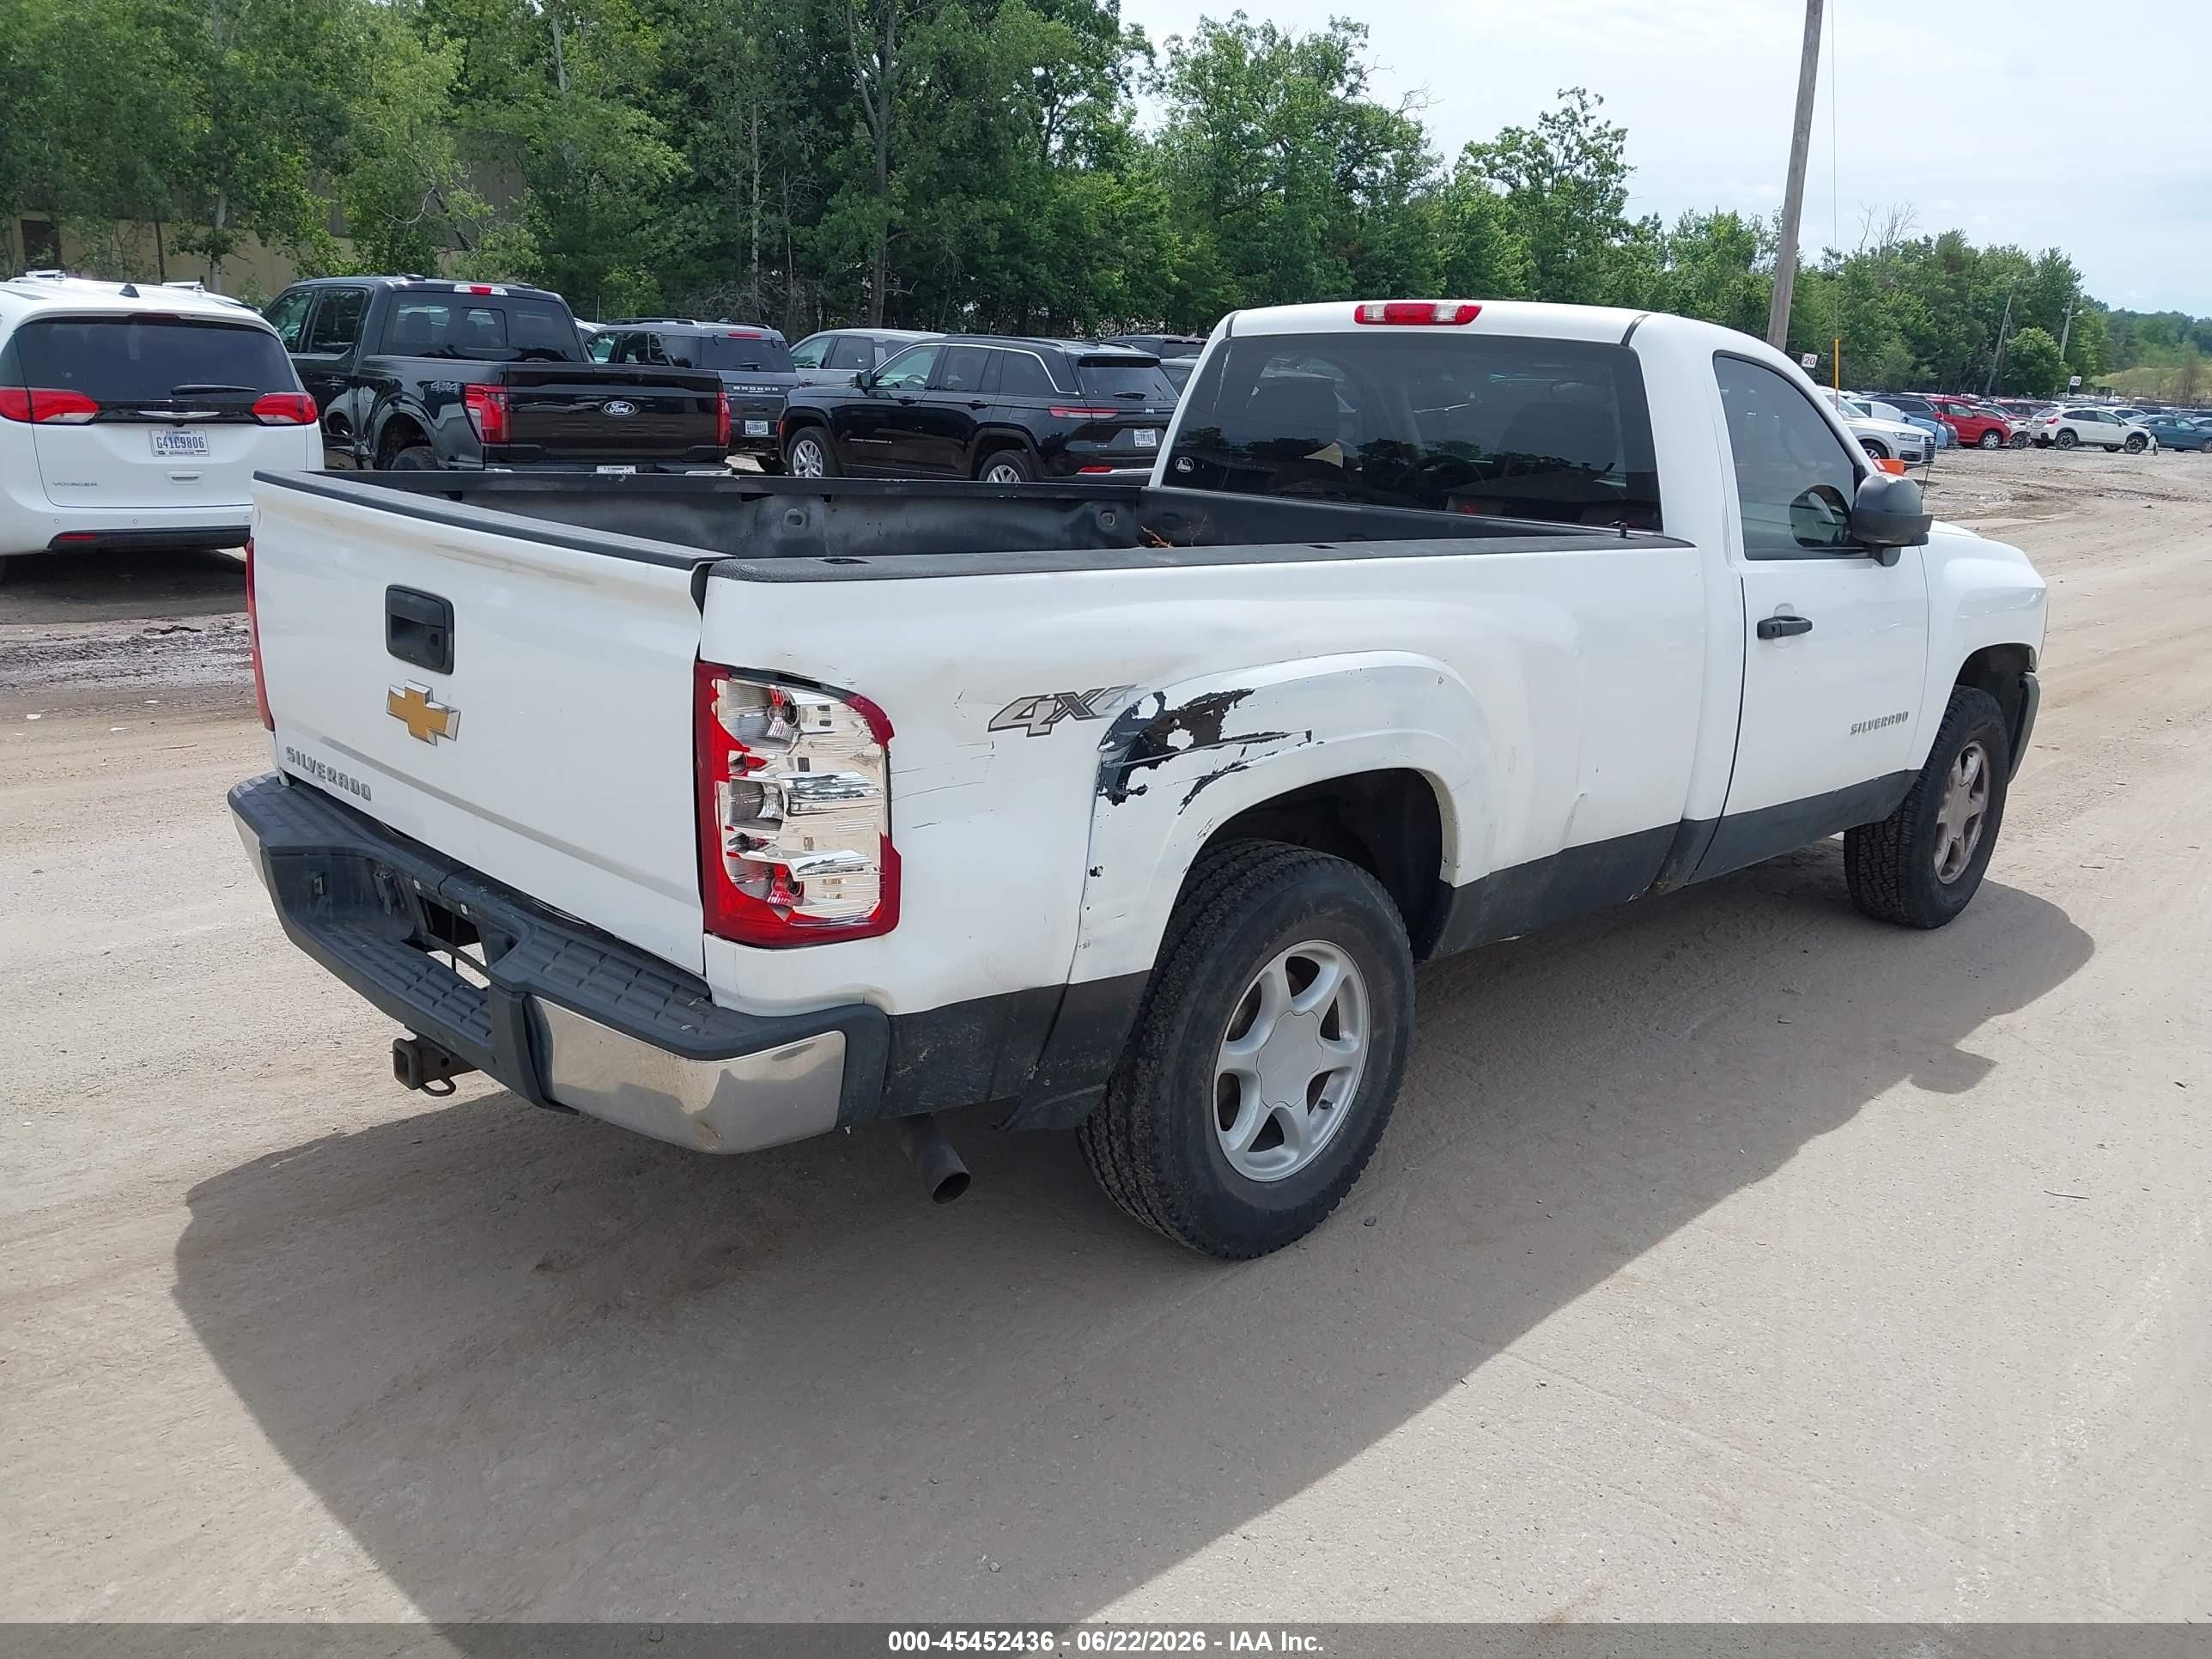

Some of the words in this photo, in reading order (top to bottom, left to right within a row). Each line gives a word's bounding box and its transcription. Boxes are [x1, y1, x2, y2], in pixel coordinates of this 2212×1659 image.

[1804, 356, 1816, 365] 20
[609, 403, 630, 413] Ford
[1850, 711, 1909, 736] SILVERADO
[285, 745, 372, 801] SILVERADO
